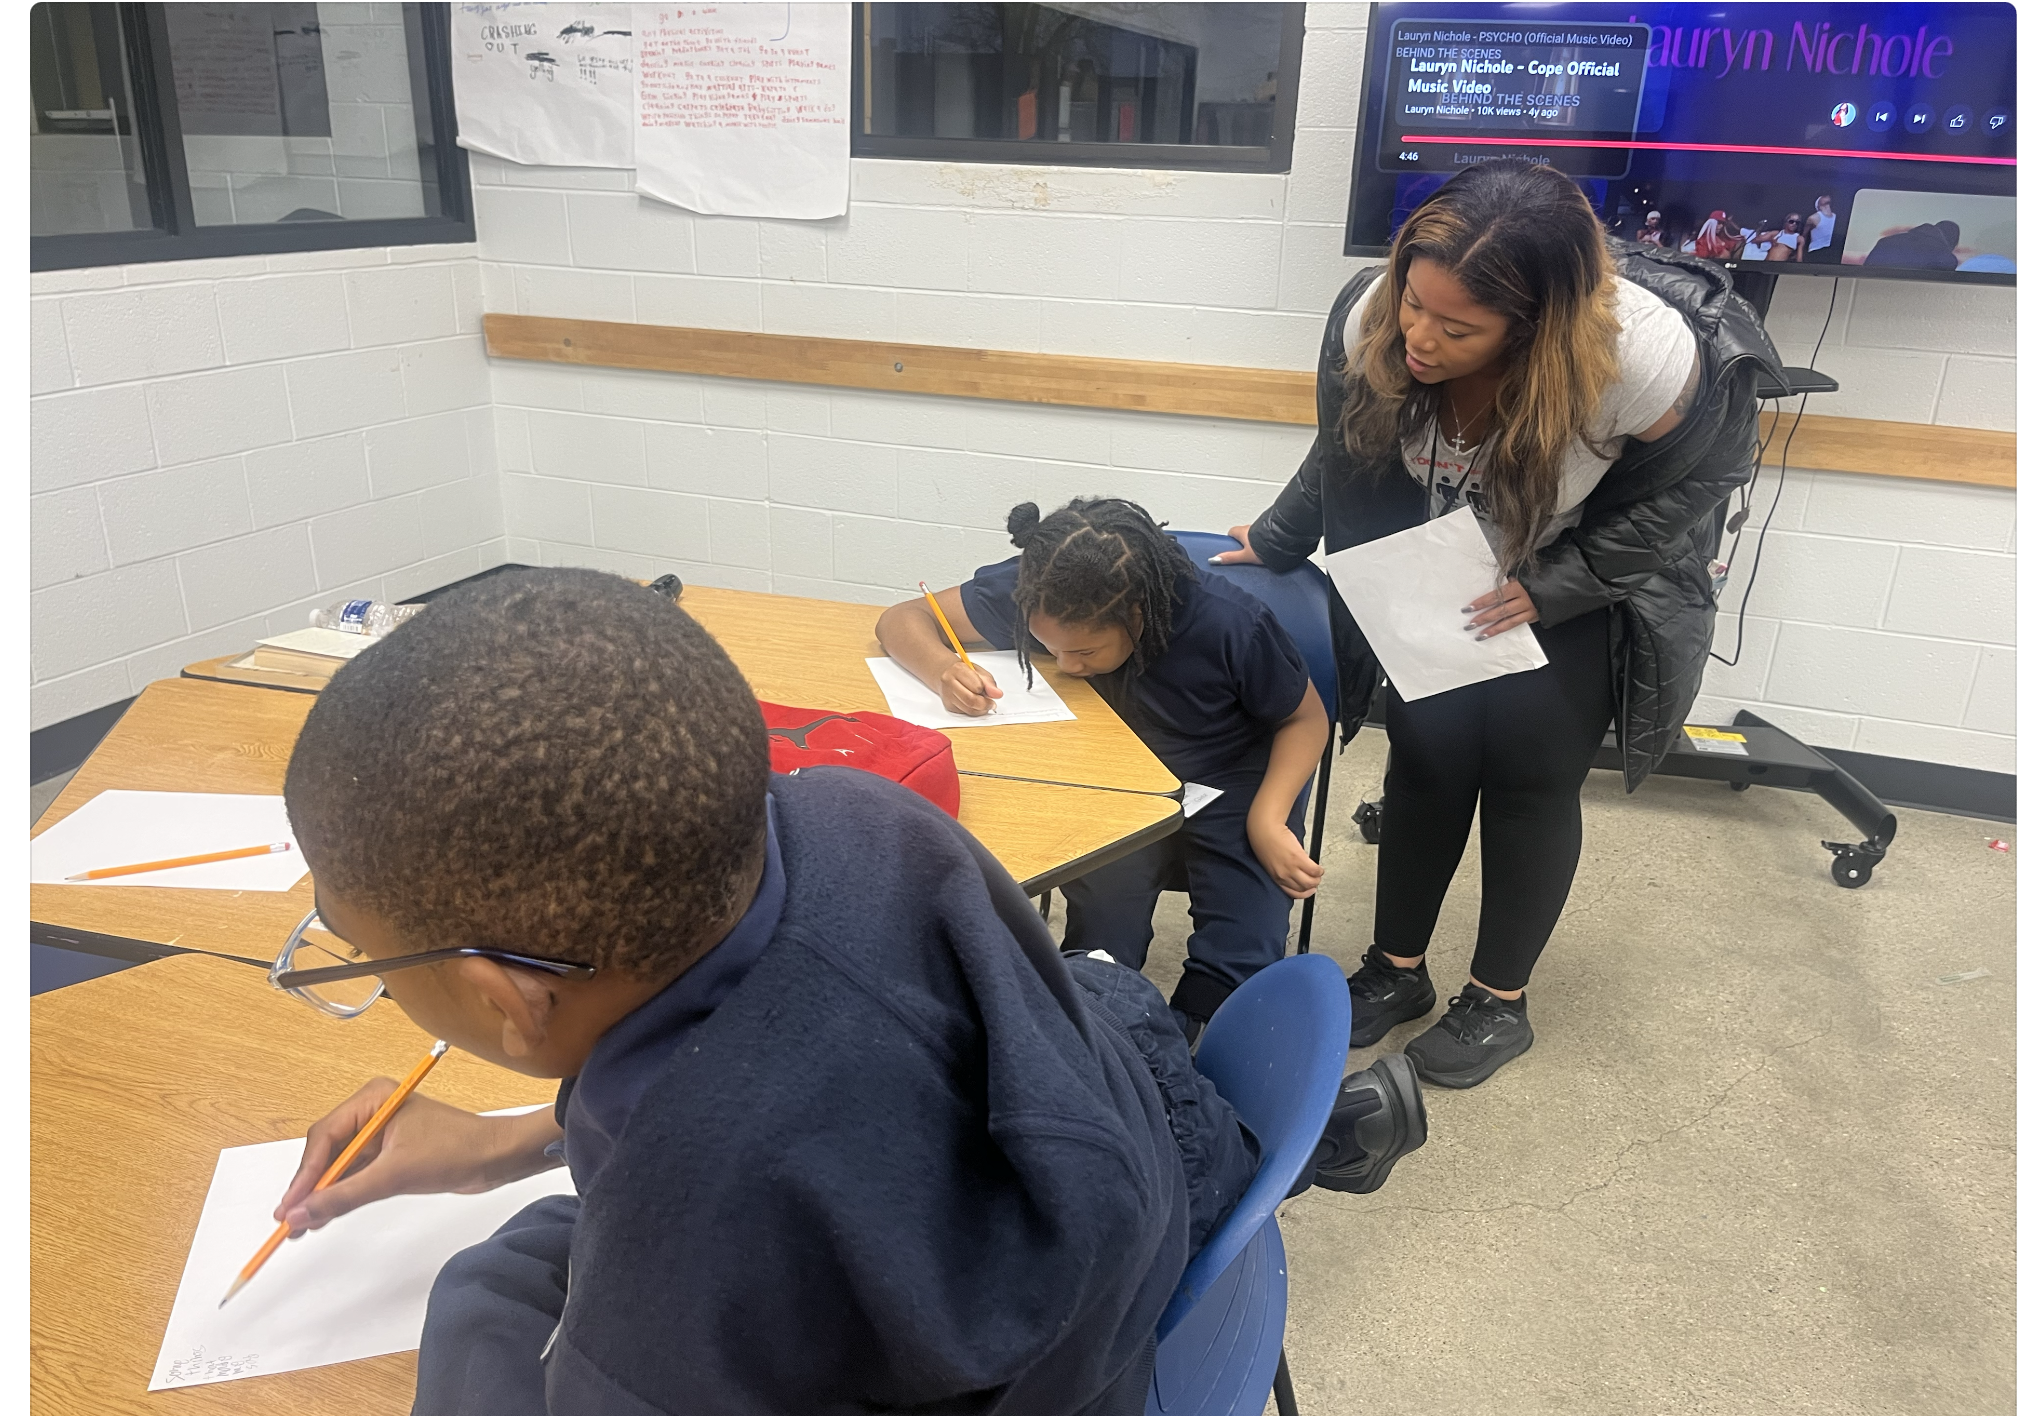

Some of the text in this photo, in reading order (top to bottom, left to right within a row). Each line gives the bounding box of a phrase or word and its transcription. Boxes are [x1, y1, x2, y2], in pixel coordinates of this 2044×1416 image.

[481, 23, 537, 40] CRASHING
[1398, 30, 1431, 43] Lauryn
[1433, 31, 1471, 42] Nichole
[1479, 32, 1522, 43] PSYCHO
[1524, 32, 1564, 45] (Official
[1566, 33, 1597, 44] Music
[1600, 34, 1633, 47] Video)
[1396, 47, 1502, 59] BEHIND THE SCENES
[1629, 15, 1953, 79] auryn Nichole
[1410, 58, 1457, 75] Lauryn
[1461, 59, 1514, 74] Nichole
[1528, 60, 1563, 77] Cope
[1567, 61, 1620, 77] Official
[1407, 78, 1492, 94] Music Video
[1442, 92, 1580, 106] BEHIND THE SCENES
[1405, 104, 1558, 118] Lauryn Nichole 10K views 4y ago
[1399, 152, 1419, 161] 4:46
